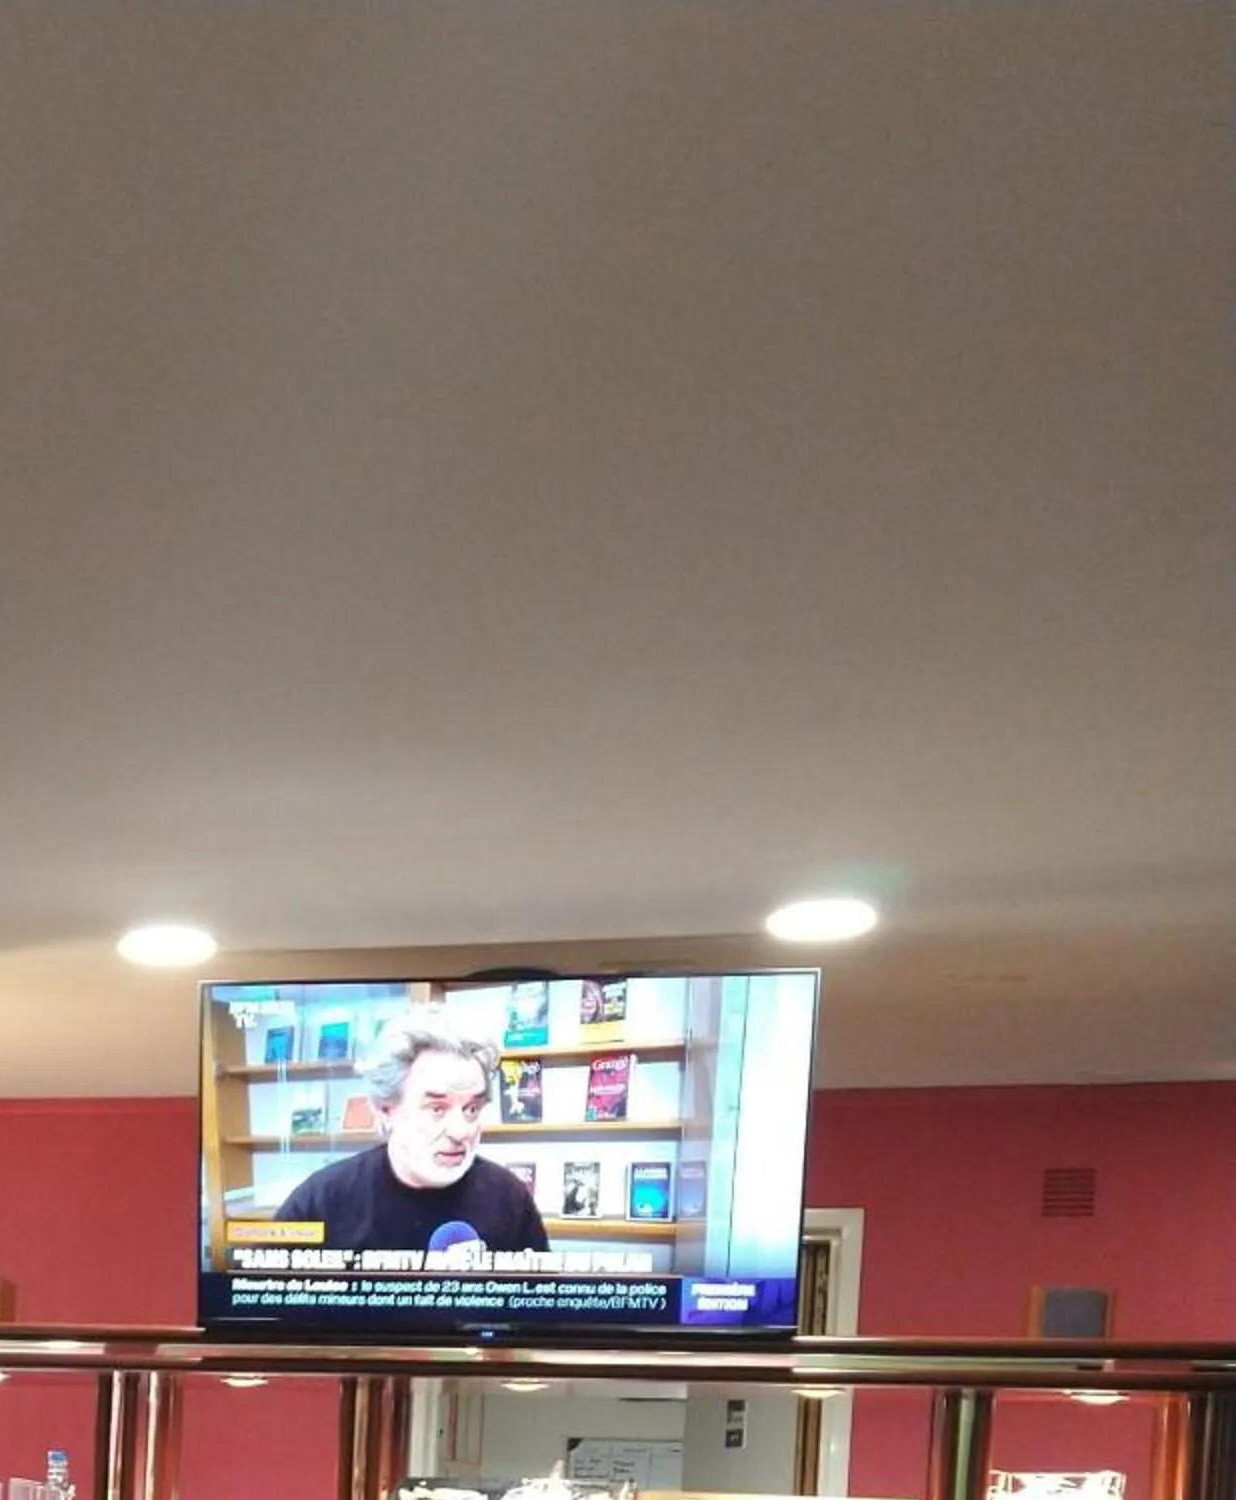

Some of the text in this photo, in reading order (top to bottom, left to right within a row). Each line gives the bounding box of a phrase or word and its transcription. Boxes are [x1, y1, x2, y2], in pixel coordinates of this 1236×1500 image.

[374, 1282, 423, 1295] suspect
[424, 1281, 440, 1293] de
[442, 1281, 459, 1293] 23
[485, 1282, 521, 1294] Owen
[557, 1284, 596, 1295] connu
[597, 1283, 614, 1295] de
[616, 1283, 628, 1295] la
[629, 1283, 667, 1297] police
[231, 1294, 260, 1306] pour
[261, 1293, 282, 1305] des
[318, 1294, 366, 1306] mineurs
[367, 1294, 395, 1306] dont
[396, 1296, 413, 1306] un
[436, 1294, 452, 1306] de
[454, 1295, 504, 1307] violence
